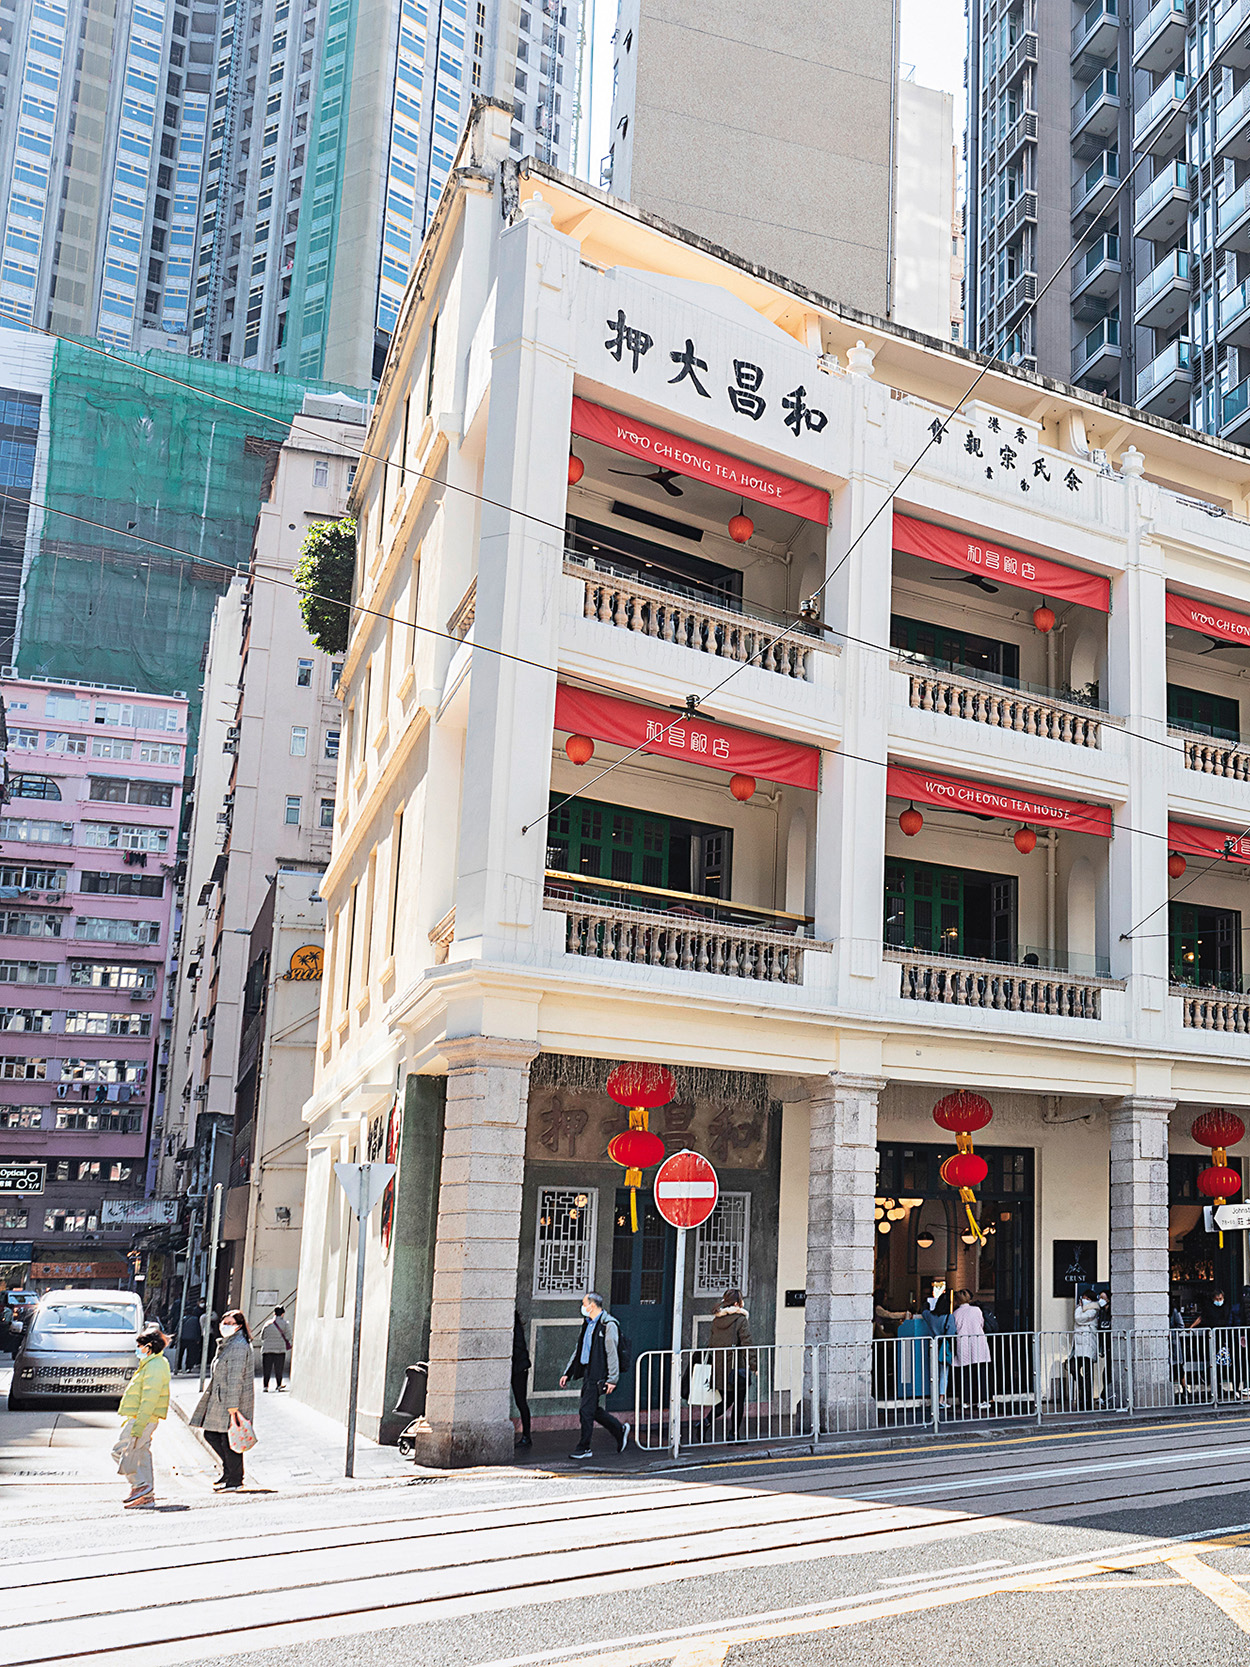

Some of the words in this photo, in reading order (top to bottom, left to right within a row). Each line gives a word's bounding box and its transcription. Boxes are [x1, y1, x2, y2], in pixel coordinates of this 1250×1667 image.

[617, 427, 650, 449] WOO
[654, 441, 711, 473] CHEONG
[715, 464, 738, 482] TEA
[741, 474, 783, 498] HOUSE
[1191, 611, 1215, 626] WOO
[925, 781, 956, 797] WOO
[957, 788, 1008, 808] CHEONG
[1011, 799, 1031, 814] TEA
[1034, 804, 1071, 820] HOUSE
